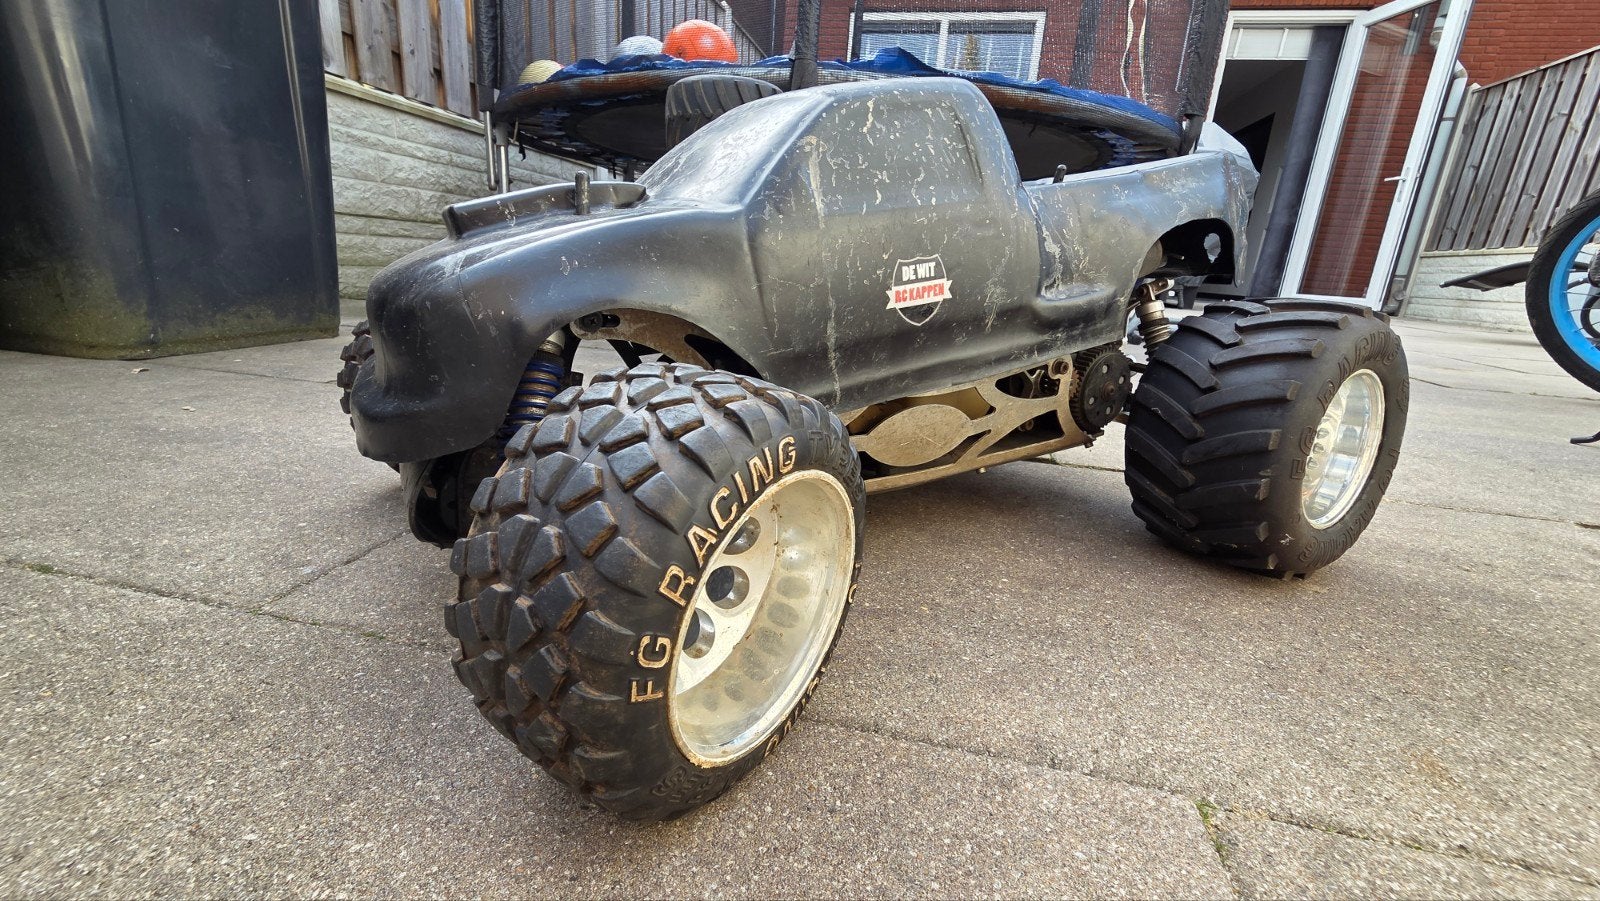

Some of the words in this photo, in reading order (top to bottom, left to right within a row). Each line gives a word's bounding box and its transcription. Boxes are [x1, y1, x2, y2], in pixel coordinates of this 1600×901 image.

[902, 265, 916, 281] DE
[916, 262, 936, 279] WIT
[894, 289, 908, 304] RC
[909, 283, 944, 301] KAPPEN
[630, 634, 672, 703] FG
[658, 435, 797, 608] RACING
